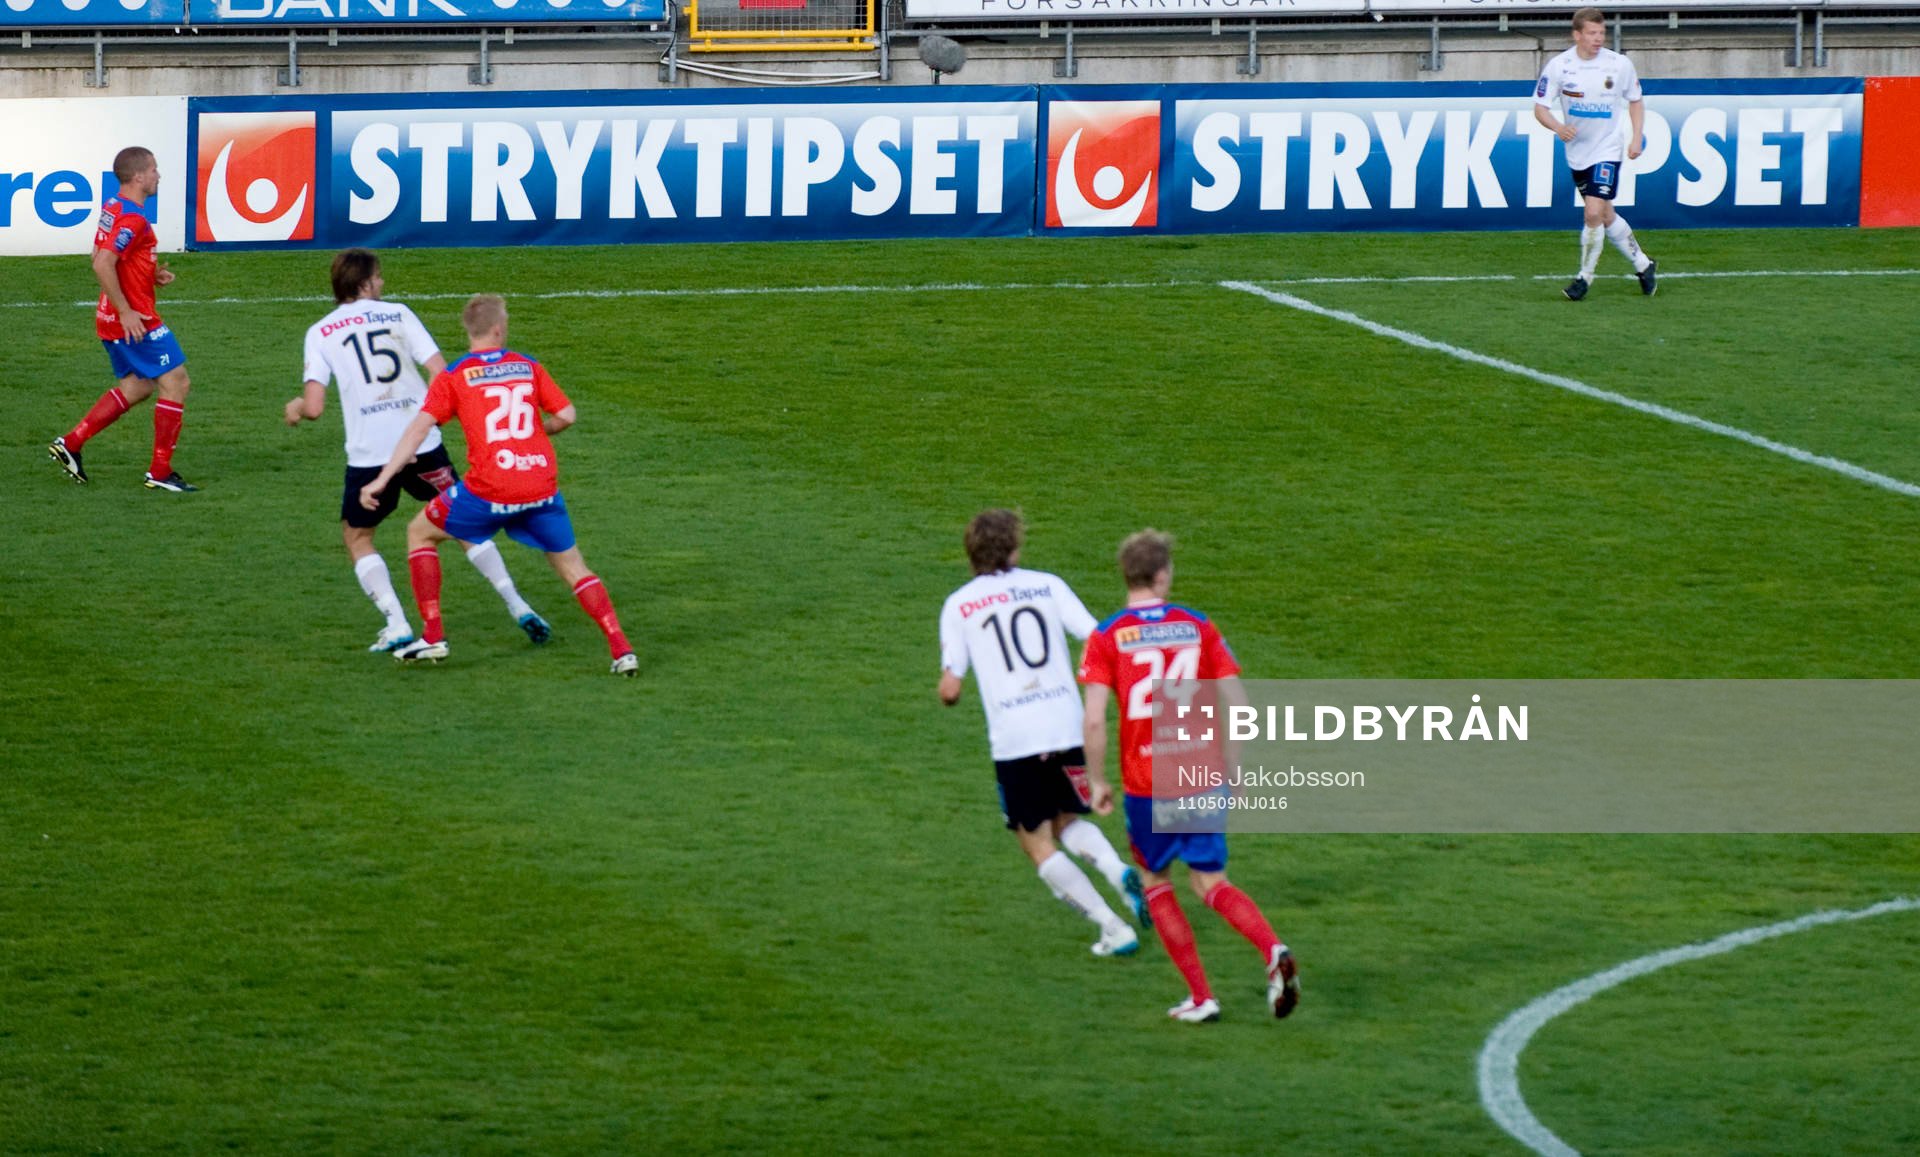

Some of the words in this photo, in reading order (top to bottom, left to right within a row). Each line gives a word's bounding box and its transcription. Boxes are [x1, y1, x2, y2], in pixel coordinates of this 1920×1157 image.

[349, 114, 1019, 225] STRYKTIPSET
[1191, 107, 1843, 212] STRYKTPSET
[160, 353, 170, 366] 21
[342, 328, 402, 384] 15
[484, 383, 534, 444] 26
[981, 605, 1050, 673] 10
[1127, 646, 1201, 720] 24
